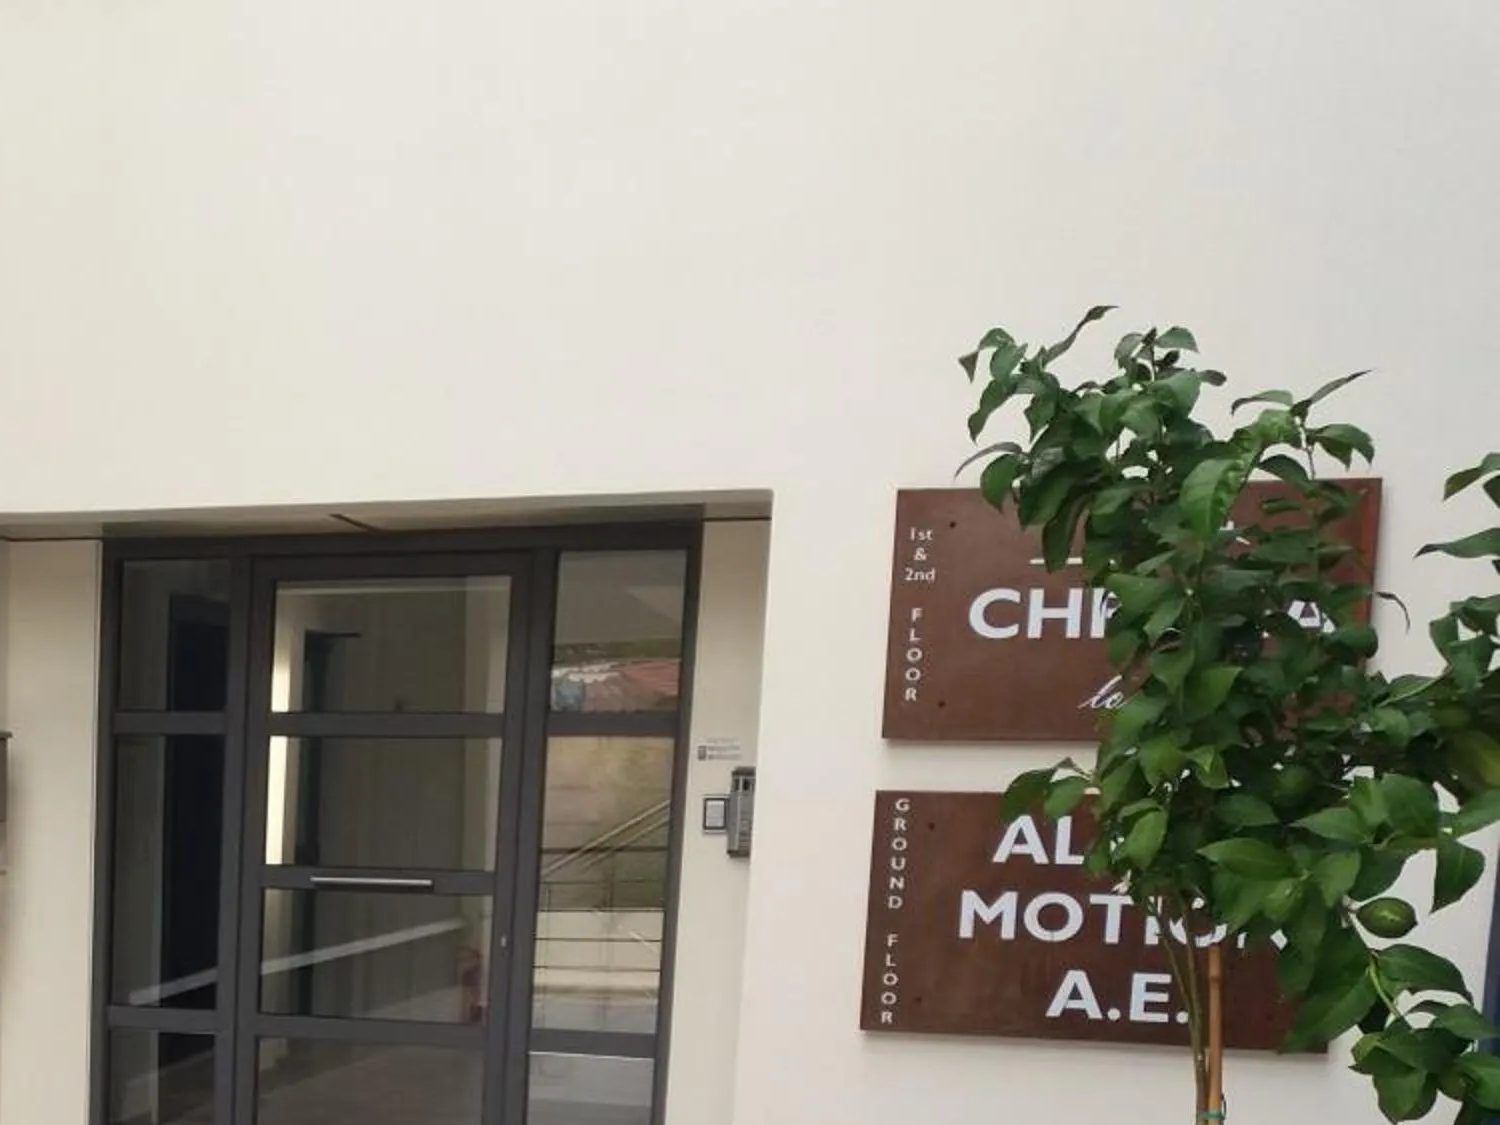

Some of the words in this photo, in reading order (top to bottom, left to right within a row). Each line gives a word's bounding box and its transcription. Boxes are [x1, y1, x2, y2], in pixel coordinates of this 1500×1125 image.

[909, 526, 934, 542] 1st
[913, 546, 928, 562] &
[904, 566, 936, 583] 2nd
[904, 607, 924, 702] FLOOR
[887, 798, 912, 910] GROUND
[880, 933, 899, 1025] FLOOR
[1045, 969, 1190, 1024] A.E.
